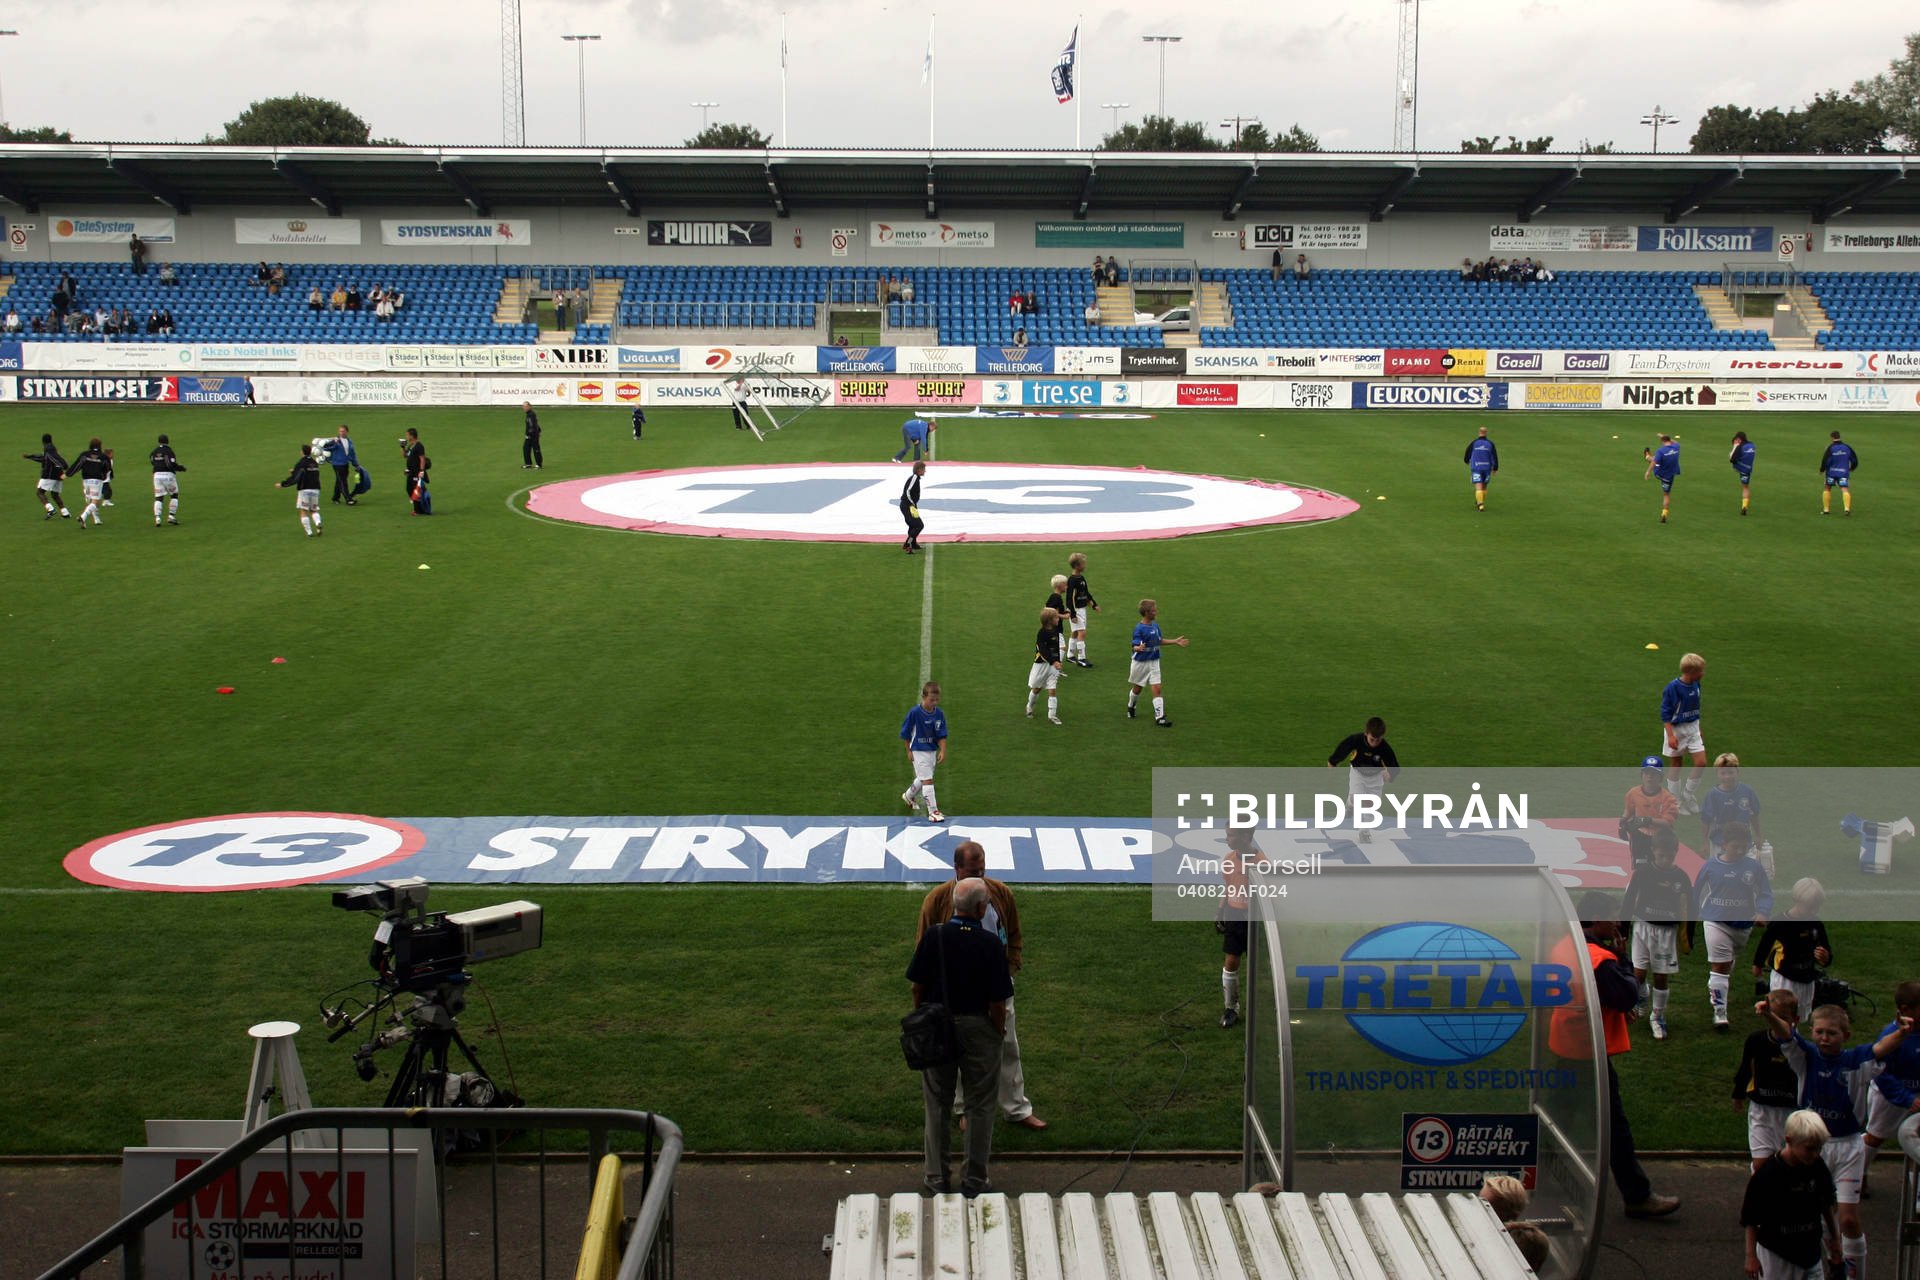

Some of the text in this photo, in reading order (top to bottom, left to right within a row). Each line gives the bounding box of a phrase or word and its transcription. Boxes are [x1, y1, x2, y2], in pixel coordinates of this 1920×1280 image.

[74, 220, 135, 235] TeleSystem
[397, 226, 492, 238] SYDSVENSKAN
[664, 223, 729, 244] PUMA
[1086, 224, 1116, 232] ombord
[1118, 225, 1129, 234] på
[1131, 224, 1182, 233] stadsbussen!
[1256, 227, 1293, 241] TCT
[895, 230, 927, 240] metso
[957, 230, 989, 240] metso
[1656, 227, 1753, 251] Folksam
[1844, 235, 1894, 248] Trelleborgs
[201, 347, 297, 356] Akzo Nobel Inks
[552, 349, 608, 363] NIBE
[623, 354, 675, 364] UGGLARPS
[735, 352, 796, 369] sydkraft
[1128, 356, 1179, 367] Tryckfrihet.
[1195, 357, 1258, 367] SKANSKA
[1276, 356, 1315, 368] Trebolit
[1329, 354, 1382, 364] INTERSPORT
[1392, 358, 1431, 366] CRAMO
[1457, 358, 1484, 366] Rental
[1499, 354, 1540, 369] Gasell
[1567, 354, 1608, 369] Gasell
[1730, 360, 1843, 369] Interbus
[829, 362, 884, 372] TRELLEBORG
[910, 362, 964, 372] TRELLEBORG
[988, 362, 1042, 372] TRELLEBORG
[23, 379, 149, 399] STRYKTIPSET
[493, 388, 520, 396] MALMÖ
[657, 387, 722, 397] SKANSKA
[840, 381, 888, 397] SPORT
[917, 381, 965, 397] SPORT
[995, 382, 1011, 403] 3
[1033, 381, 1093, 404] tre.se
[1113, 382, 1130, 404] 3
[1181, 387, 1221, 395] LINDAHL
[1292, 383, 1333, 402] FORSBERGS
[1373, 387, 1480, 403] EURONICS
[1841, 386, 1888, 400] ALFA
[185, 393, 240, 403] TRELLEBORG
[351, 393, 398, 401] MEKANISKA
[1295, 395, 1329, 407] OPTIK
[1623, 385, 1694, 409] Nilpat
[1769, 393, 1827, 401] SPEKTRUM
[129, 831, 370, 868] 13
[1295, 964, 1574, 1009] TRETAB
[1306, 1069, 1577, 1091] TRANSPORT & SPEDITION
[1457, 1124, 1514, 1140] RÄTT ÄR
[1415, 1130, 1444, 1149] 13
[1455, 1140, 1530, 1156] RESPEKT
[173, 1159, 365, 1218] MAXI
[208, 1222, 363, 1239] STORMARKNAD
[293, 1246, 357, 1255] RELLEBORG
